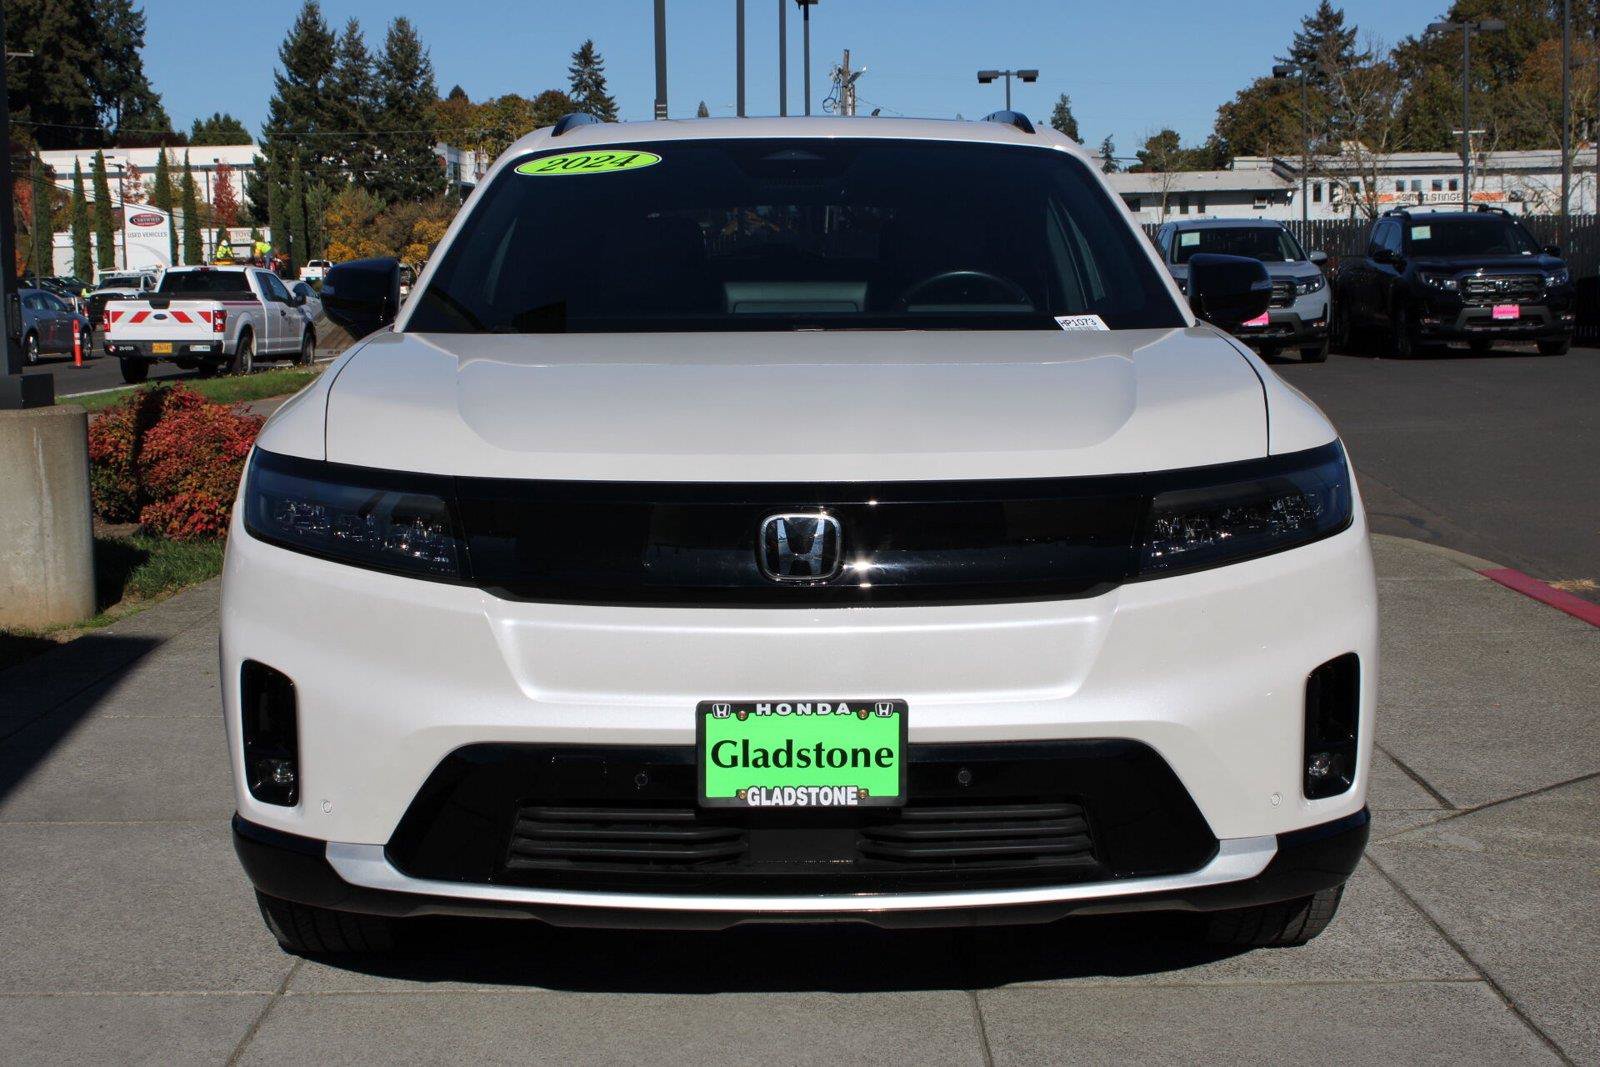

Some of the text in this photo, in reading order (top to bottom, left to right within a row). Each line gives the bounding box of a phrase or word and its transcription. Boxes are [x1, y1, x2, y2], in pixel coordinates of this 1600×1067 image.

[537, 154, 641, 172] 2024
[1059, 318, 1097, 327] HP1073
[756, 703, 851, 715] HONDA
[711, 739, 894, 768] Gladstone
[747, 786, 858, 806] GLADSTONE
